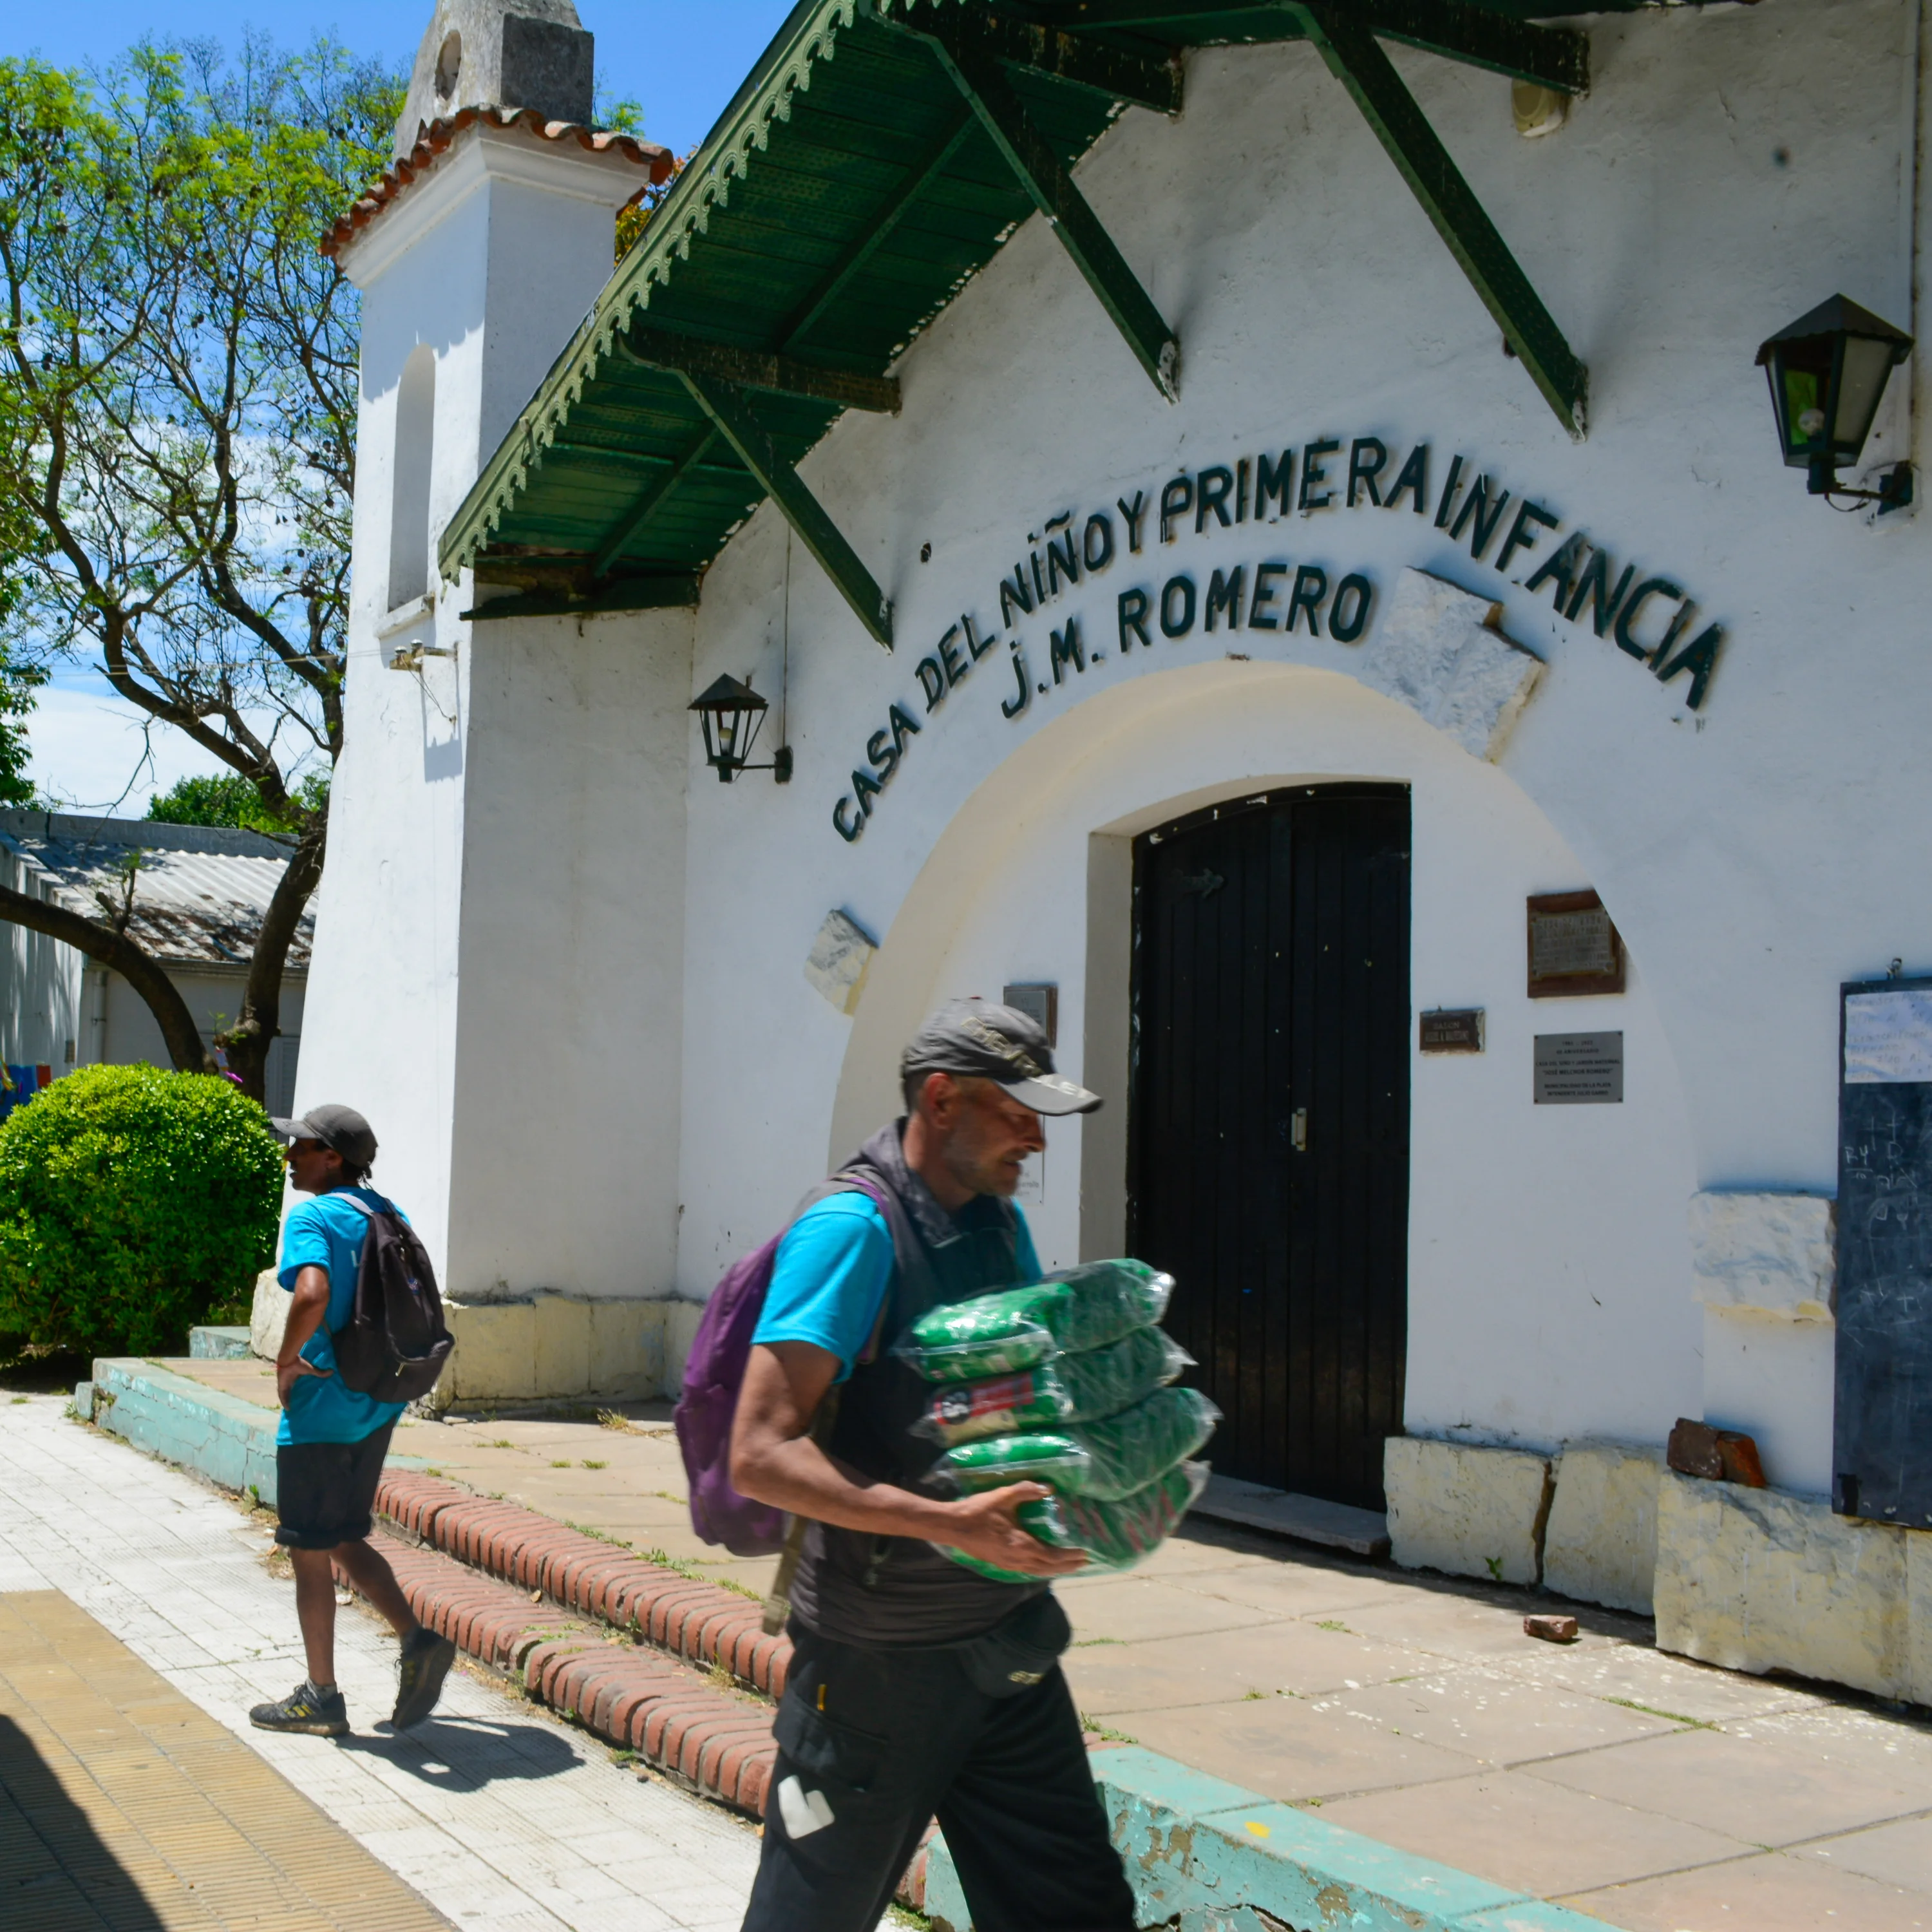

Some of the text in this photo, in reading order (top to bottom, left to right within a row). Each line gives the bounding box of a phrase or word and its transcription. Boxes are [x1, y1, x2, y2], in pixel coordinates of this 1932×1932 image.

[833, 436, 1725, 842] CASA DEL NIÑO Y PRIMERA INFANCIA
[1117, 562, 1372, 654] ROMERO
